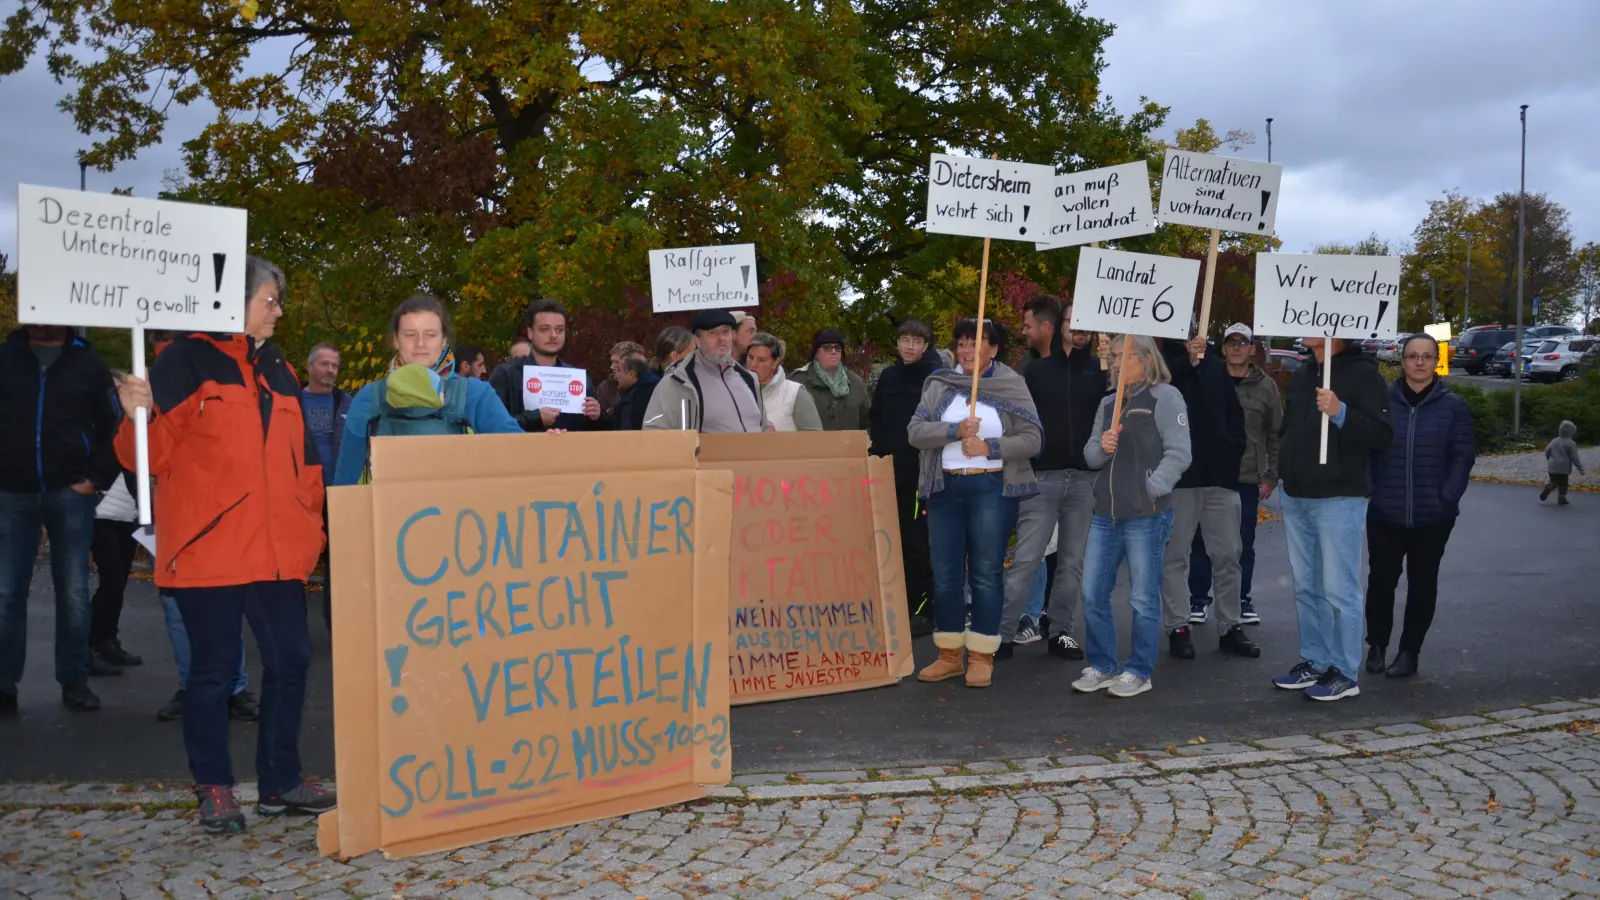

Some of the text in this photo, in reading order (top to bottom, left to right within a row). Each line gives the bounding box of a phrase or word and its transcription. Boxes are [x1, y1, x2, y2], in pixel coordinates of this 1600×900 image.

[933, 160, 1031, 194] Dietersheim
[1054, 172, 1119, 197] an muß
[1166, 155, 1262, 189] Alternativen
[1062, 196, 1109, 213] wollen
[1195, 185, 1226, 200] sind
[38, 197, 172, 237] Dezentrale
[936, 201, 978, 219] wehrt
[986, 203, 1013, 223] sich
[1170, 200, 1253, 222] vorhanden
[1050, 222, 1072, 235] err
[62, 230, 201, 283] Unterbringung
[664, 248, 736, 277] Raffgier
[1096, 257, 1157, 286] Landrat
[689, 279, 703, 287] vor
[1276, 264, 1398, 297] Wir werden
[69, 281, 129, 309] NICHT
[136, 295, 200, 326] gewollt
[1097, 285, 1175, 323] NOTE 6
[734, 474, 885, 519] MOKRATIE
[396, 481, 696, 586] CONTAINER
[738, 513, 840, 553] ODER
[738, 546, 877, 603] KTATUR
[405, 571, 628, 649] GERECHT
[736, 631, 771, 650] AUS
[774, 629, 822, 652] DEM
[806, 650, 894, 668] LANDRAT
[462, 635, 713, 722] VERTEILEN
[729, 674, 777, 696] IMME
